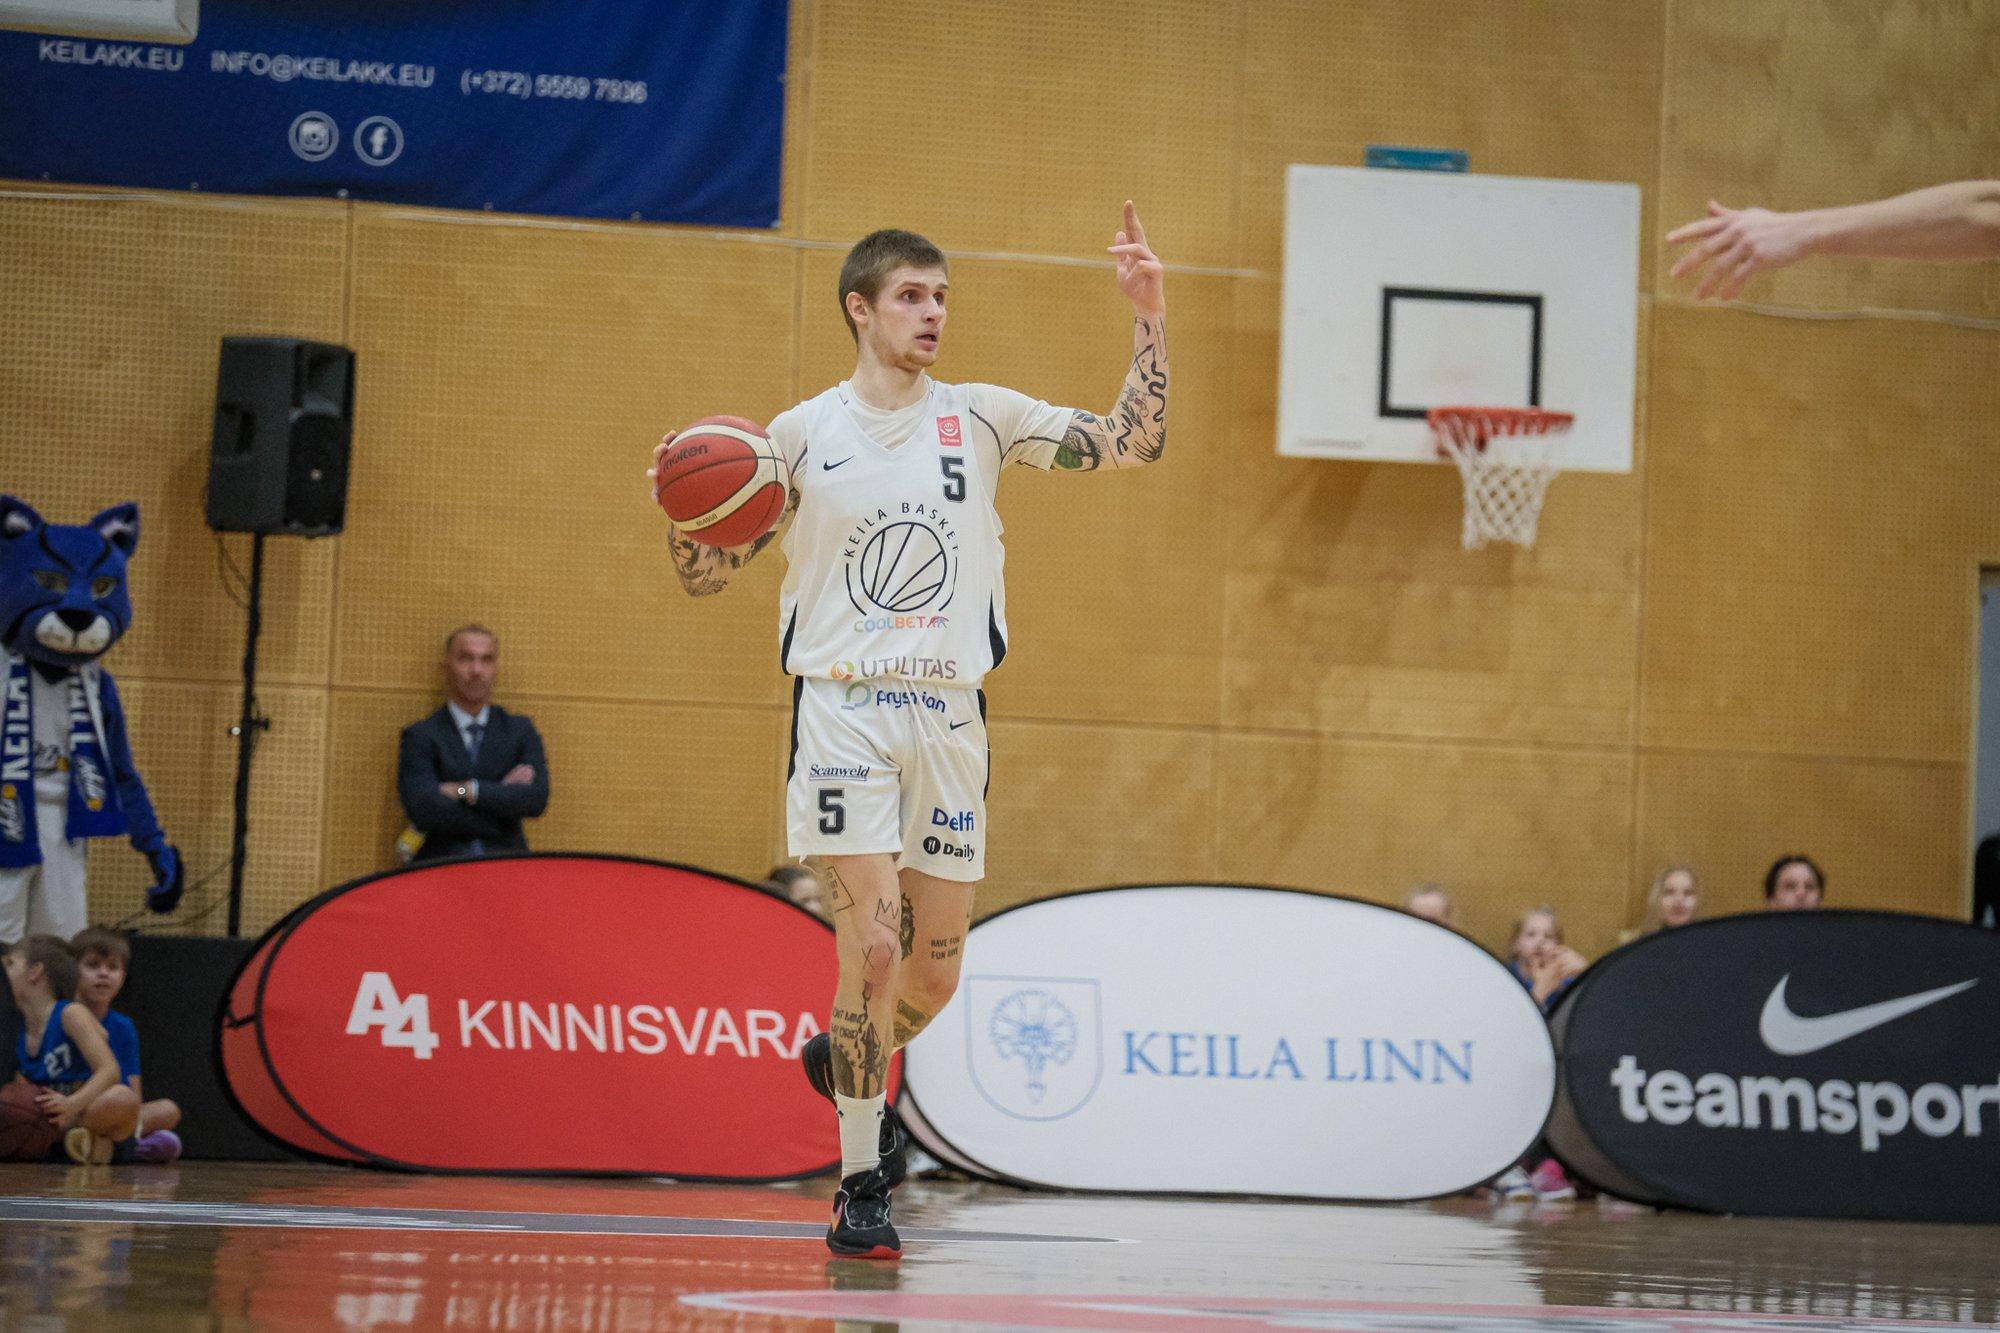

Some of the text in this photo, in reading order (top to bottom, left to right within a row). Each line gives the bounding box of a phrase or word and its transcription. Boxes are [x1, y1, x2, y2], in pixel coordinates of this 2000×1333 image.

[39, 40, 184, 72] KEILAKK.EU
[210, 50, 435, 88] INFO@KEILAKK.EU
[460, 68, 532, 100] (+372)
[940, 455, 966, 503] 5
[844, 508, 888, 558] KEILA
[854, 615, 926, 633] COOLBET
[860, 655, 957, 680] UTILITAS
[809, 763, 870, 781] Scanweld
[818, 787, 847, 836] 5
[931, 806, 975, 832] Delfi
[942, 842, 976, 862] Daily
[345, 971, 822, 1060] A4 KINNISVARA
[43, 1043, 71, 1078] 27
[1123, 1030, 1473, 1084] KEILA LINN
[1610, 1054, 2000, 1152] teamspor
